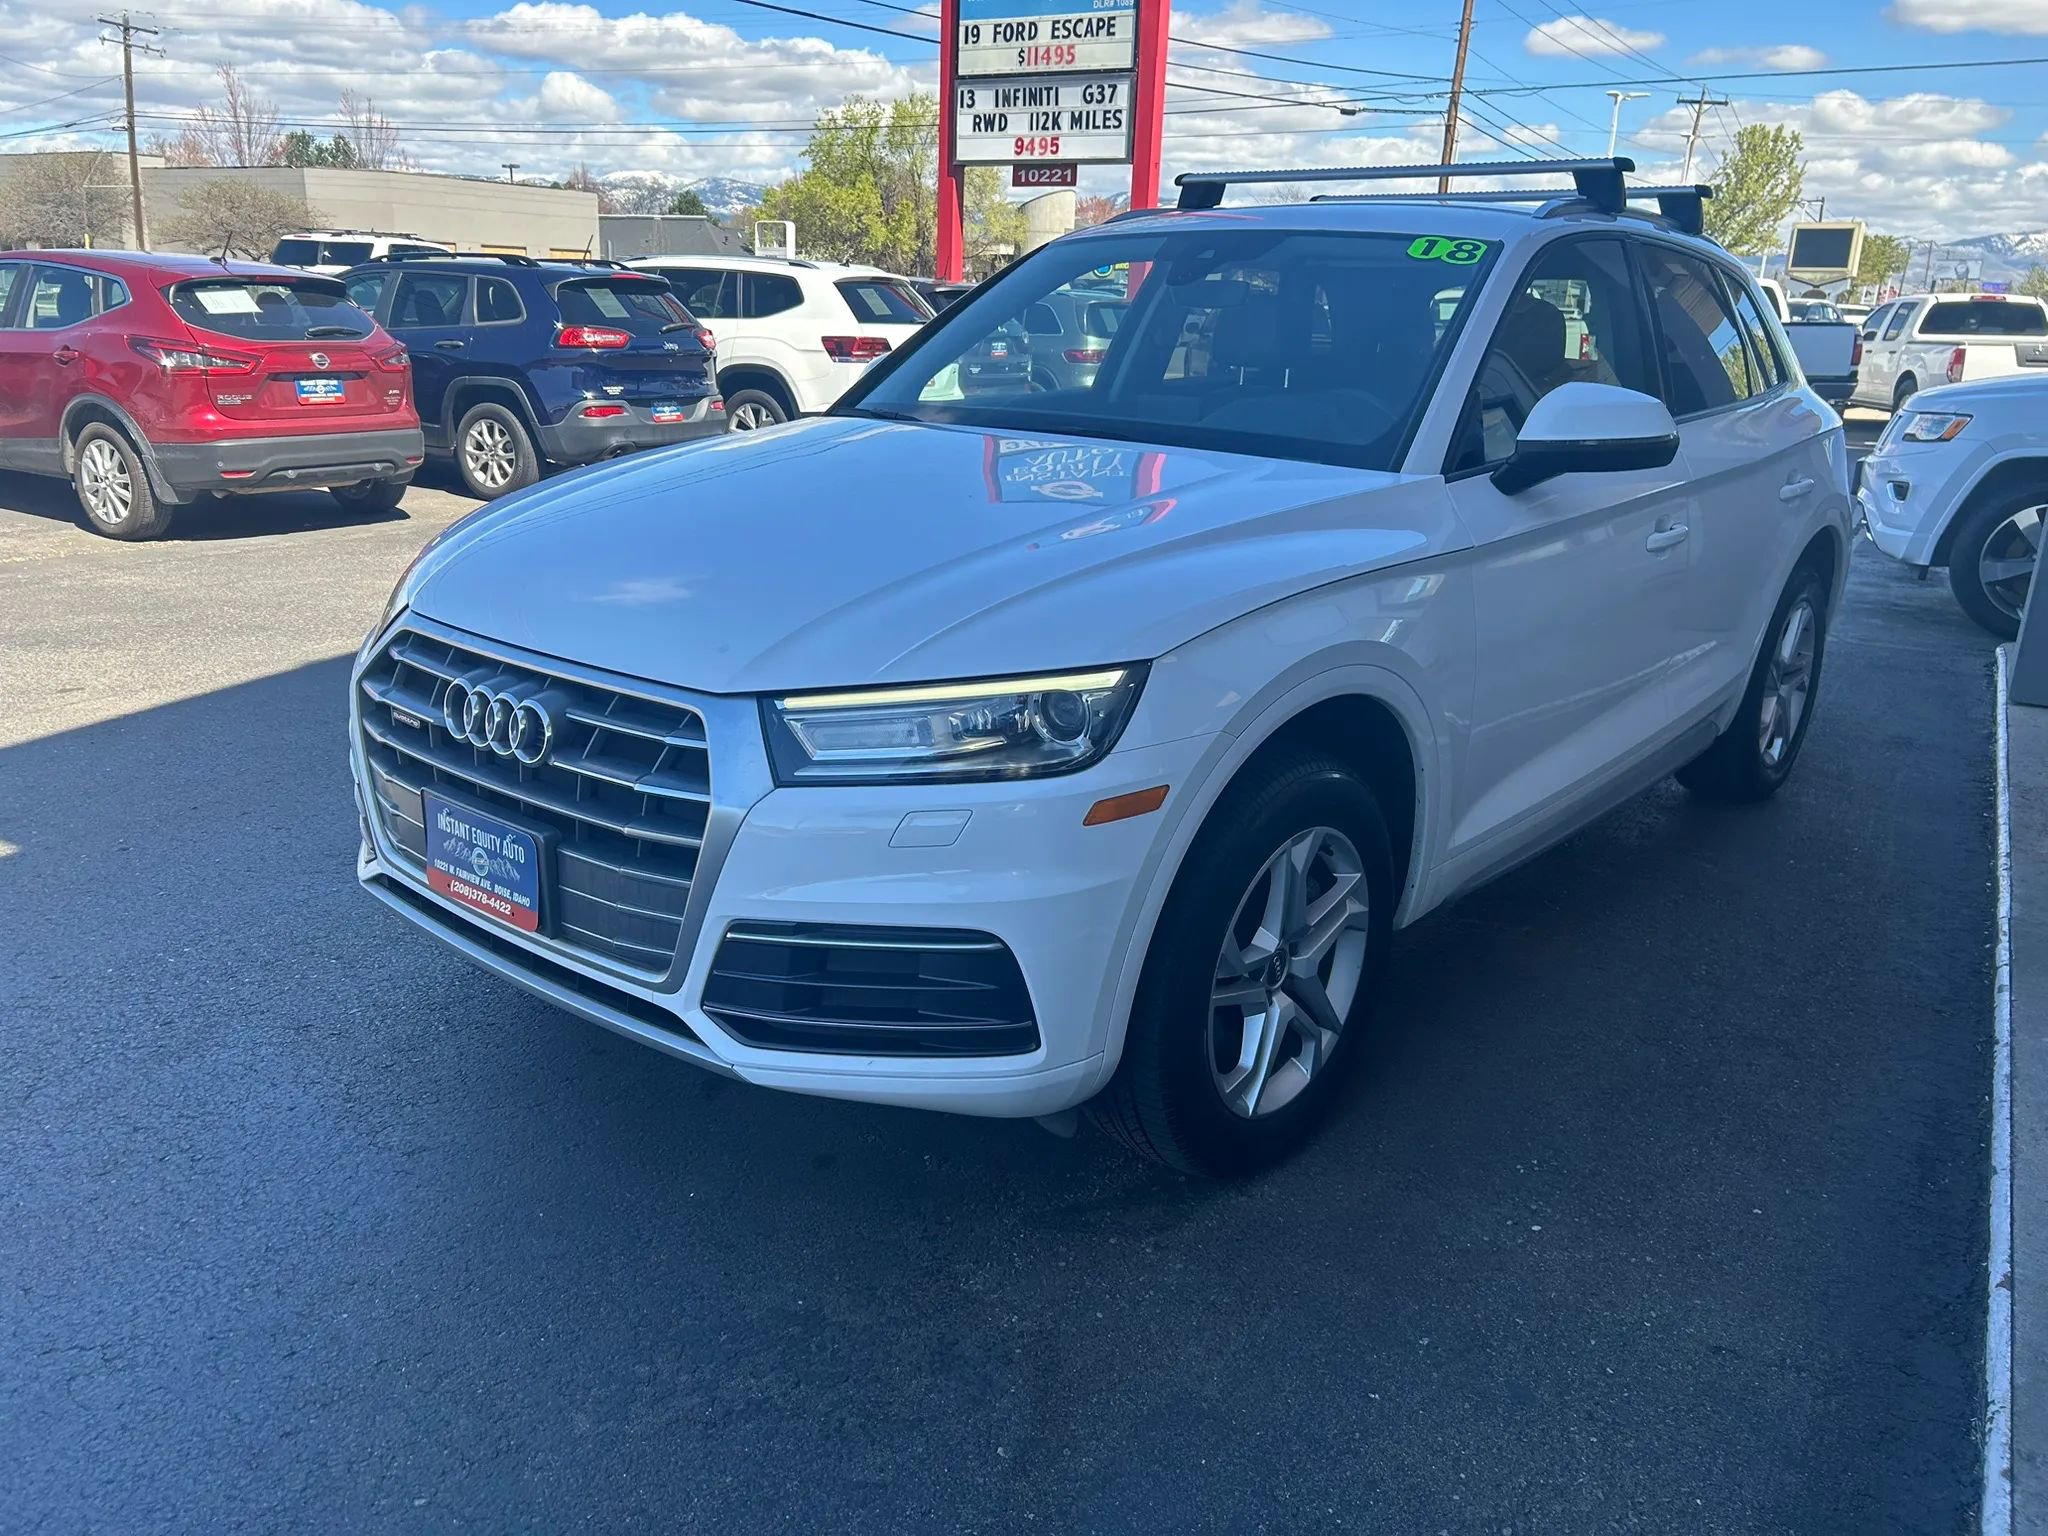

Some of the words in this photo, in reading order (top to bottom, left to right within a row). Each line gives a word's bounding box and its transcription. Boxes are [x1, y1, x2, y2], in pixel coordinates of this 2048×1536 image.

[964, 25, 980, 44] 19
[993, 21, 1038, 43] FORD
[1051, 16, 1116, 40] ESCAPE
[1018, 45, 1076, 66] $11495
[960, 89, 975, 108] 13
[994, 86, 1059, 108] INFINITI
[1082, 84, 1117, 104] G37
[973, 113, 1008, 132] RWD
[1029, 111, 1062, 131] 112K
[1070, 109, 1122, 130] MILES
[1014, 137, 1060, 156] 9495
[1017, 169, 1072, 182] 10221
[1417, 237, 1483, 262] 18
[437, 812, 470, 841] INSTANT
[471, 827, 501, 853] EQUITY
[502, 839, 525, 864] AUTO
[450, 879, 512, 915] (208)378-4422
[513, 891, 531, 908] IDAHO
